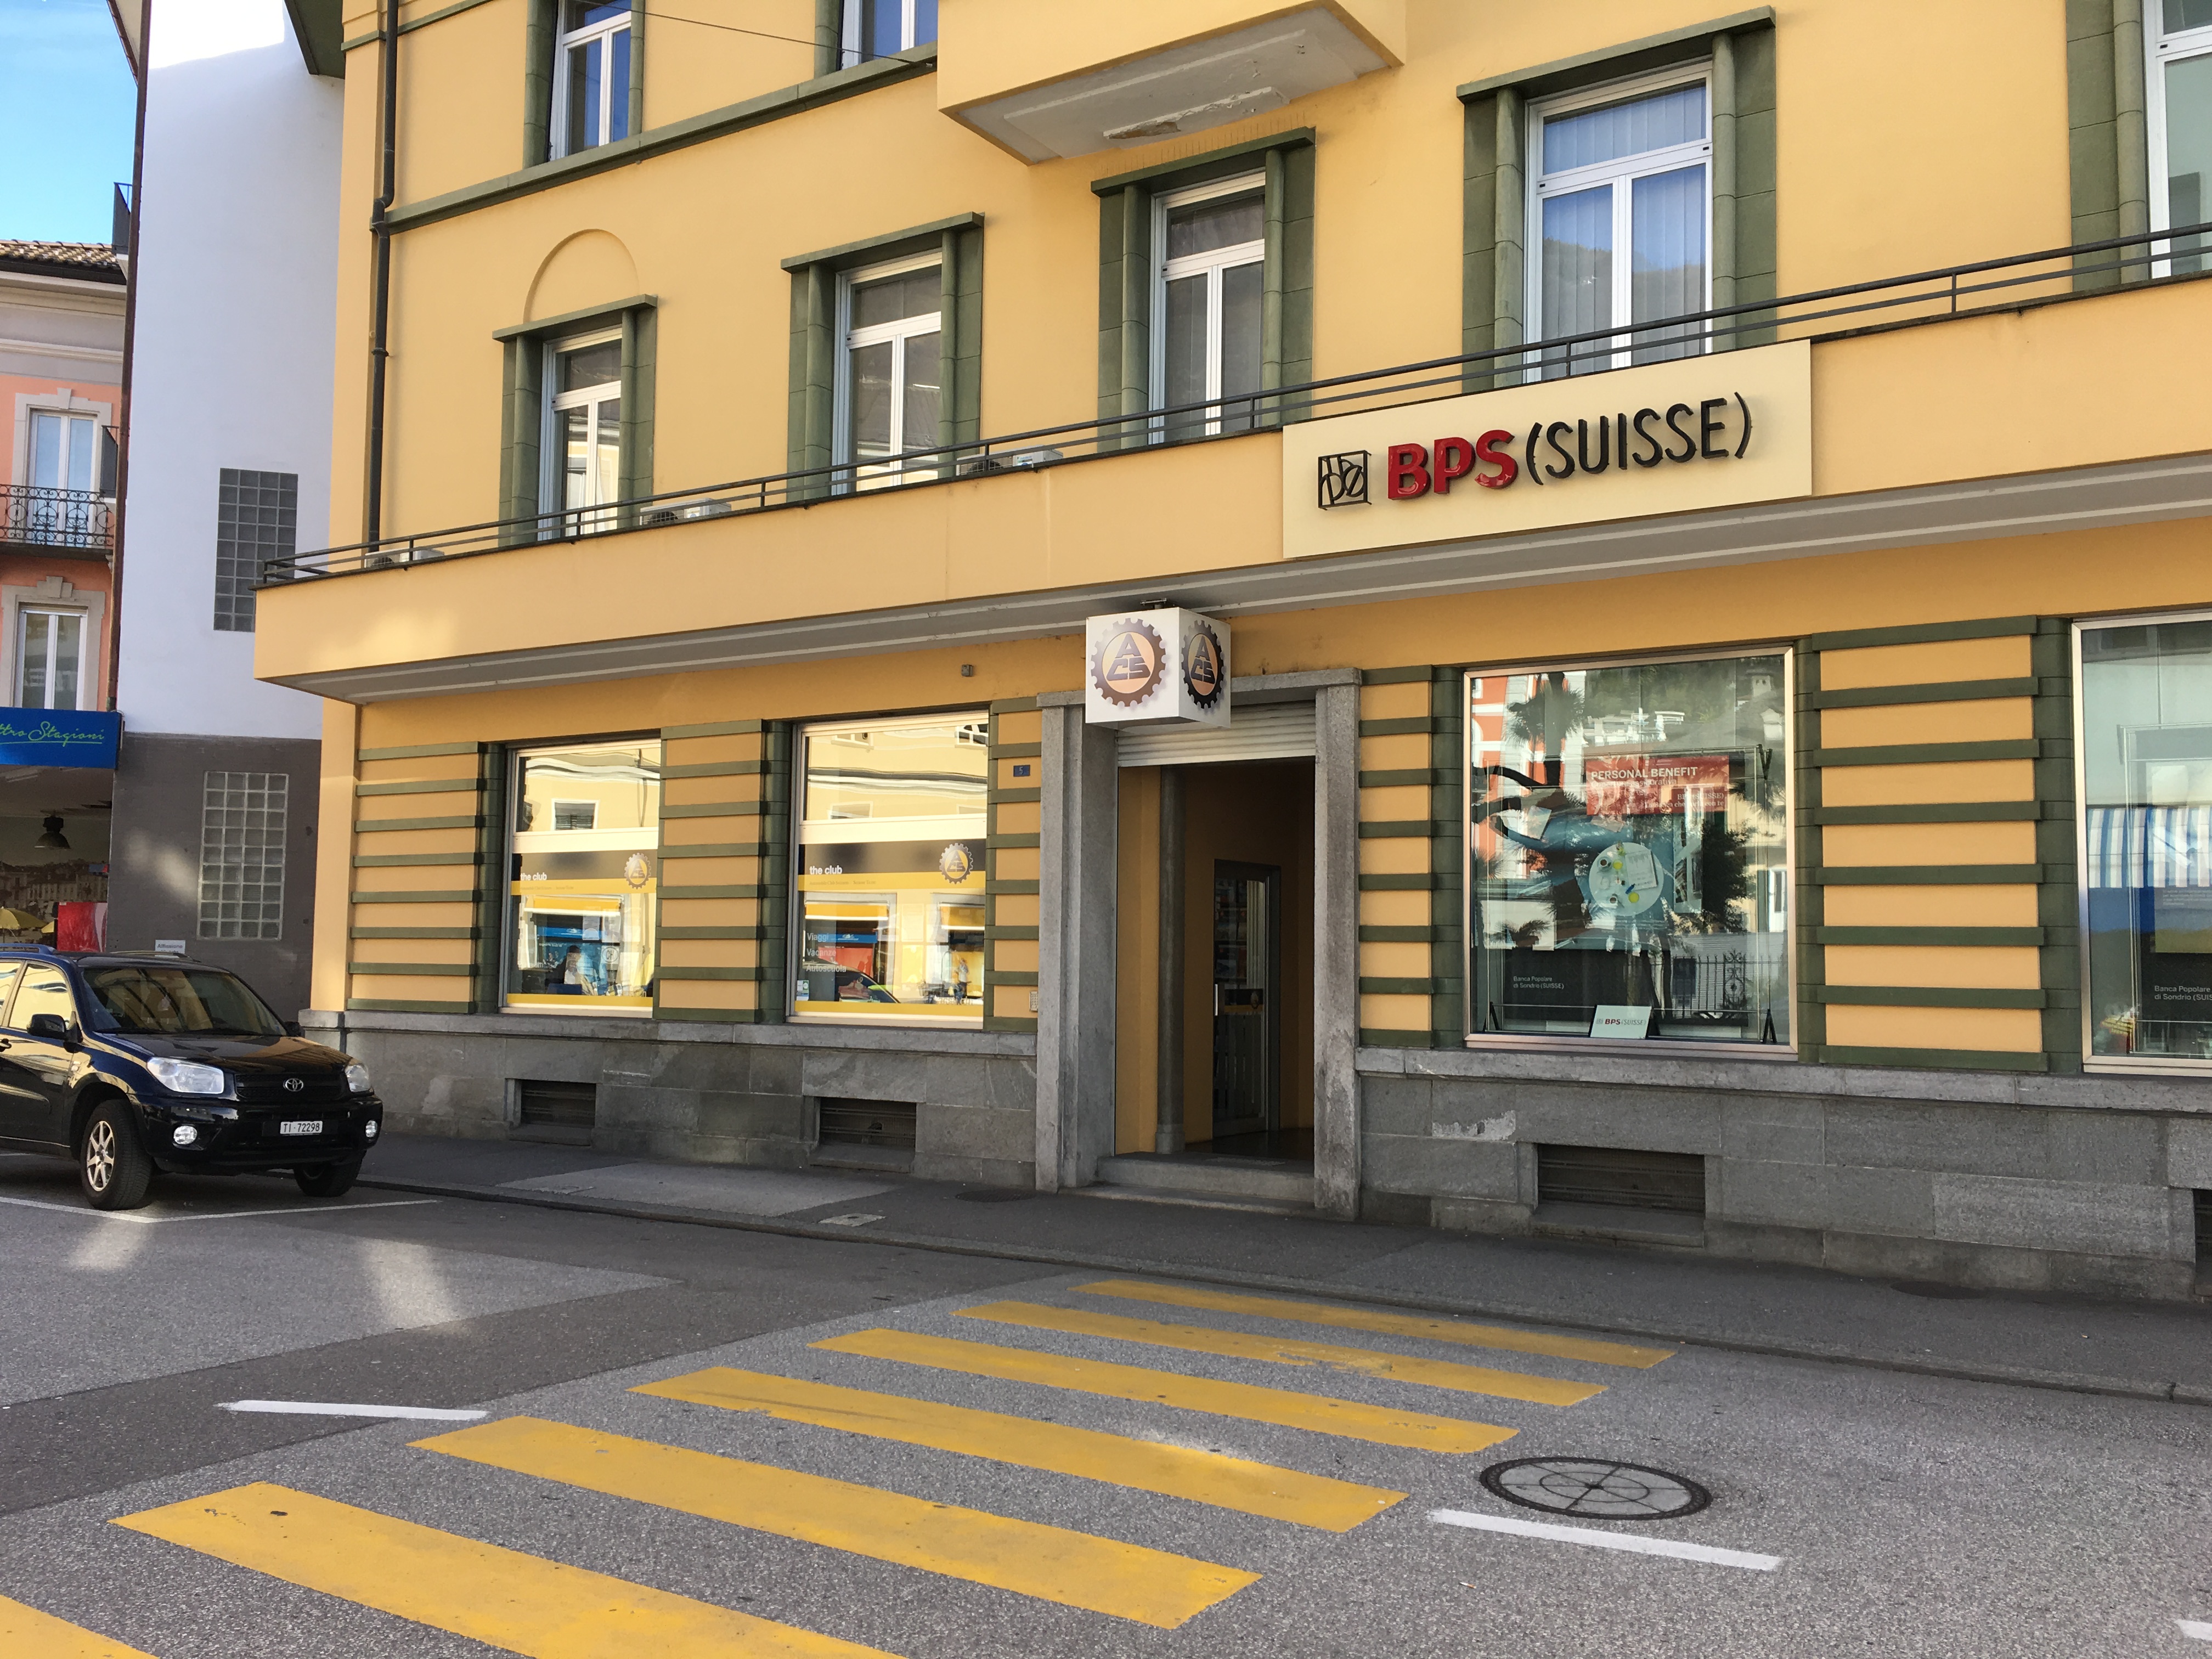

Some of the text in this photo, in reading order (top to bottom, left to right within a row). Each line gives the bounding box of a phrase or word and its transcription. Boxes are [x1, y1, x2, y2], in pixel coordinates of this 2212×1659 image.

[1388, 392, 1753, 500] BPS (SUISSE)
[29, 721, 104, 747] Stagioni
[1019, 766, 1023, 775] 5
[1591, 766, 1698, 780] PERSONAL BENEFIT
[809, 865, 843, 875] the club
[520, 872, 548, 881] the club
[807, 933, 829, 943] Viaggi
[806, 948, 837, 957] Vacanze
[806, 964, 847, 973] Autoscuola
